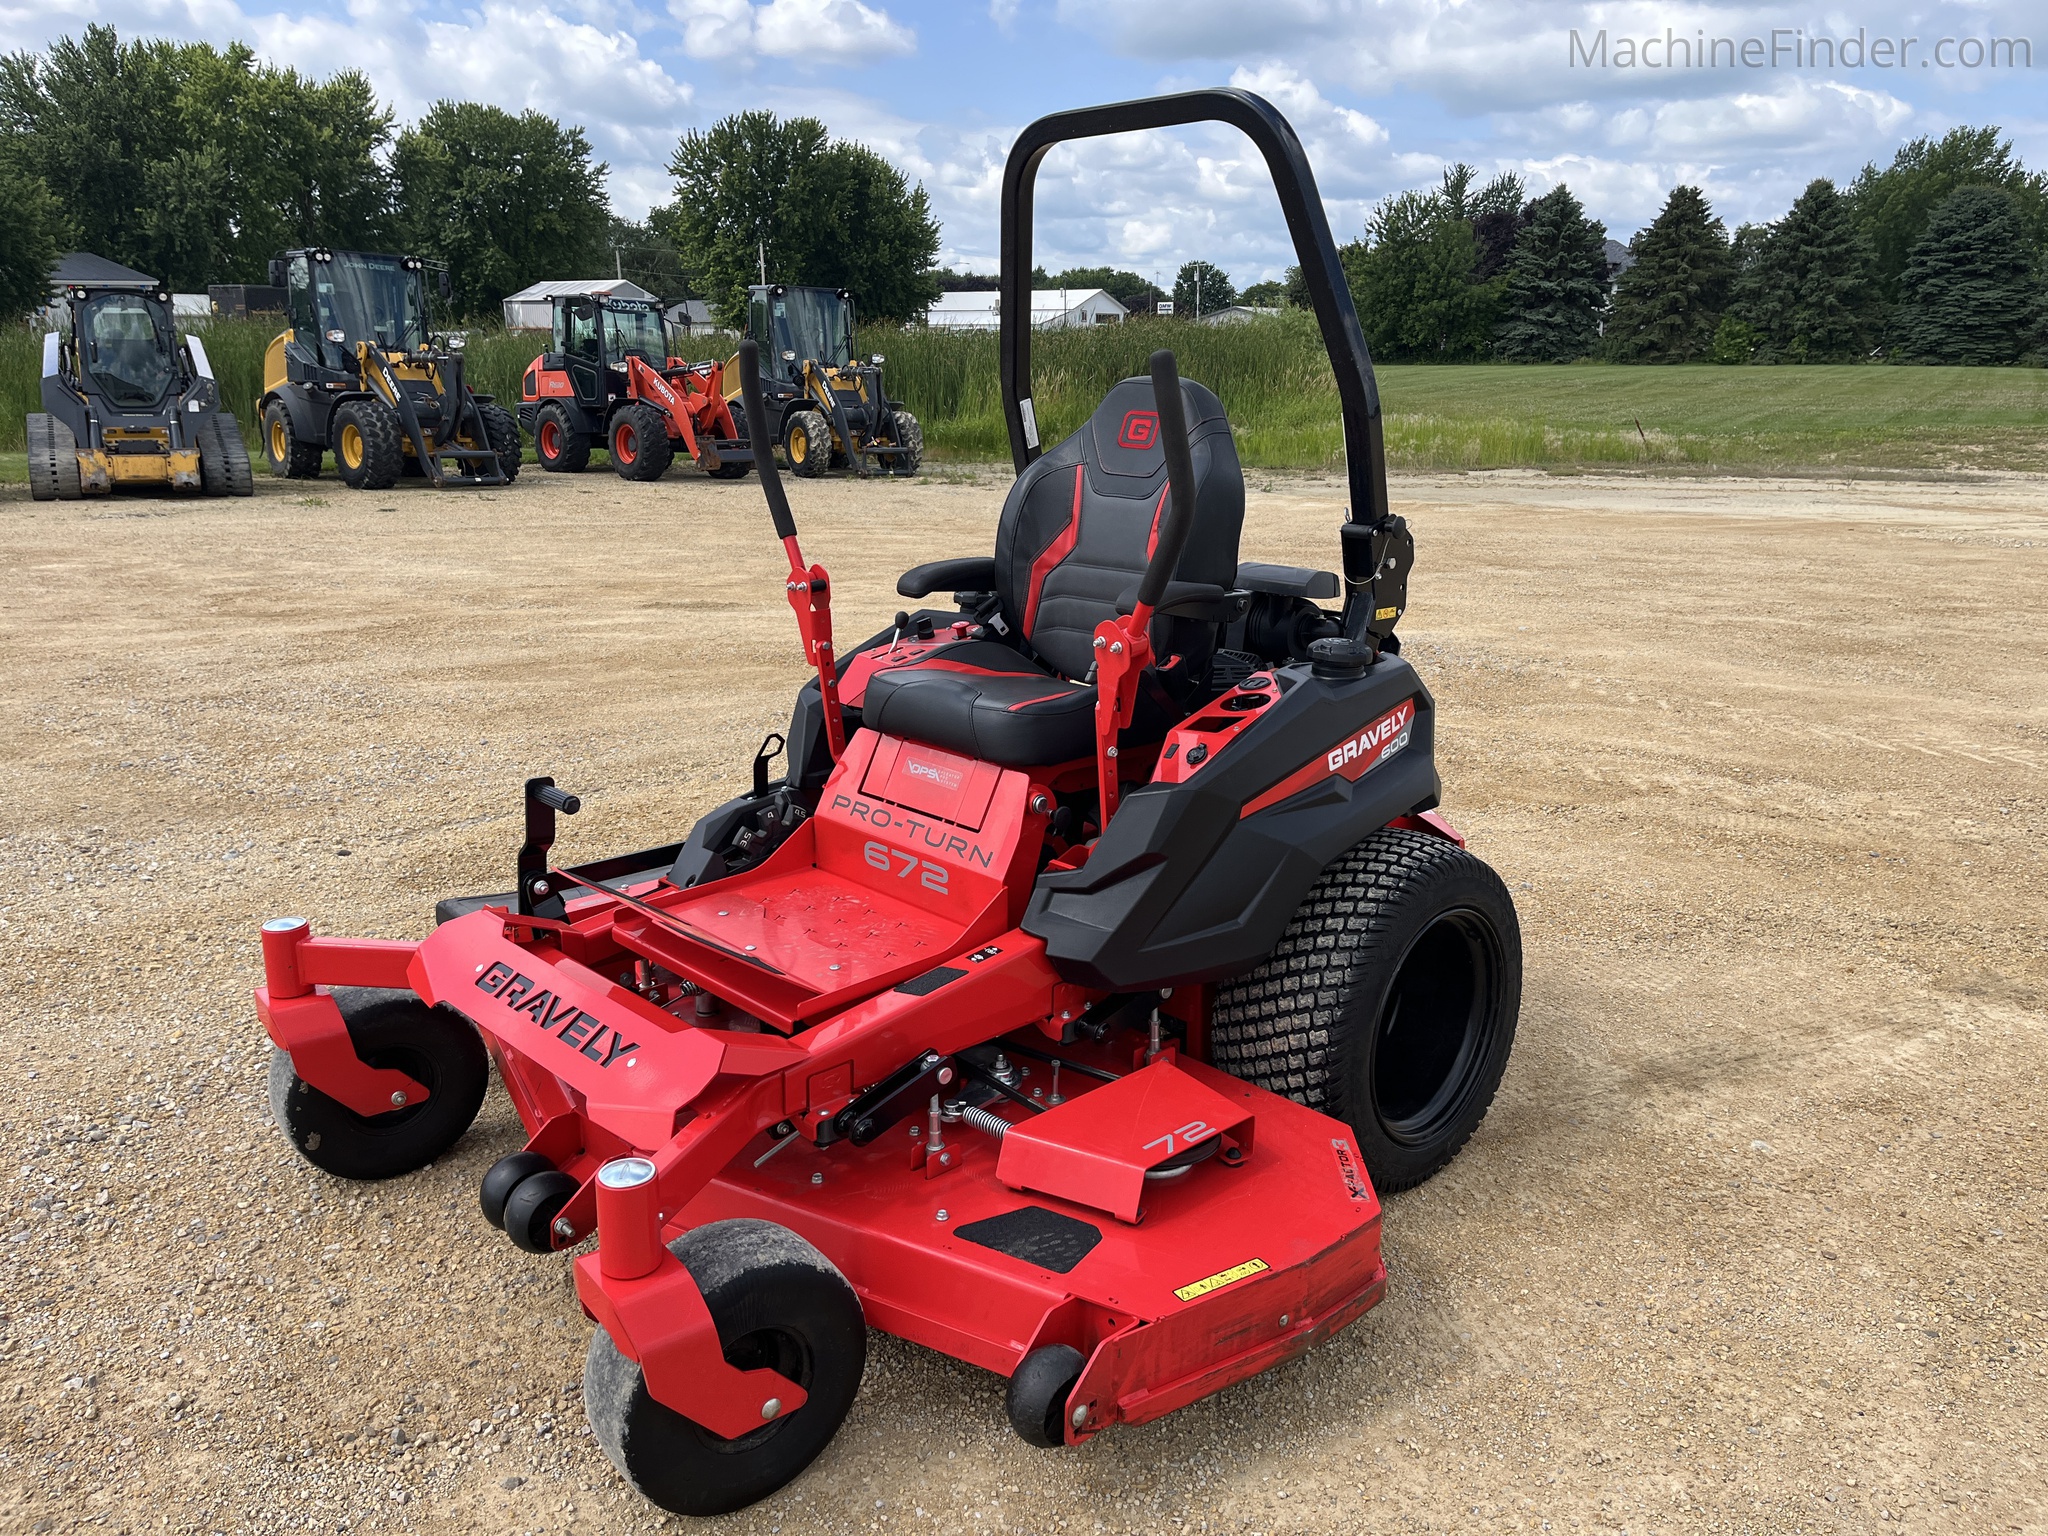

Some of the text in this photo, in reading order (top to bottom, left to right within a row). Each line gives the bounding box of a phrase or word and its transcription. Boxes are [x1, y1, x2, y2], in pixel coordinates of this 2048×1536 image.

[343, 261, 396, 272] JOHN DEERE
[382, 366, 401, 402] DEERE
[653, 377, 675, 405] KUBOTA
[822, 380, 836, 408] DEERE
[1327, 705, 1408, 772] GRAVELY
[1381, 731, 1408, 759] 600
[767, 811, 774, 819] 4
[831, 793, 994, 868] PRO-TURN
[863, 840, 949, 896] 672
[474, 960, 641, 1069] GRAVELY
[1142, 1120, 1217, 1154] 72
